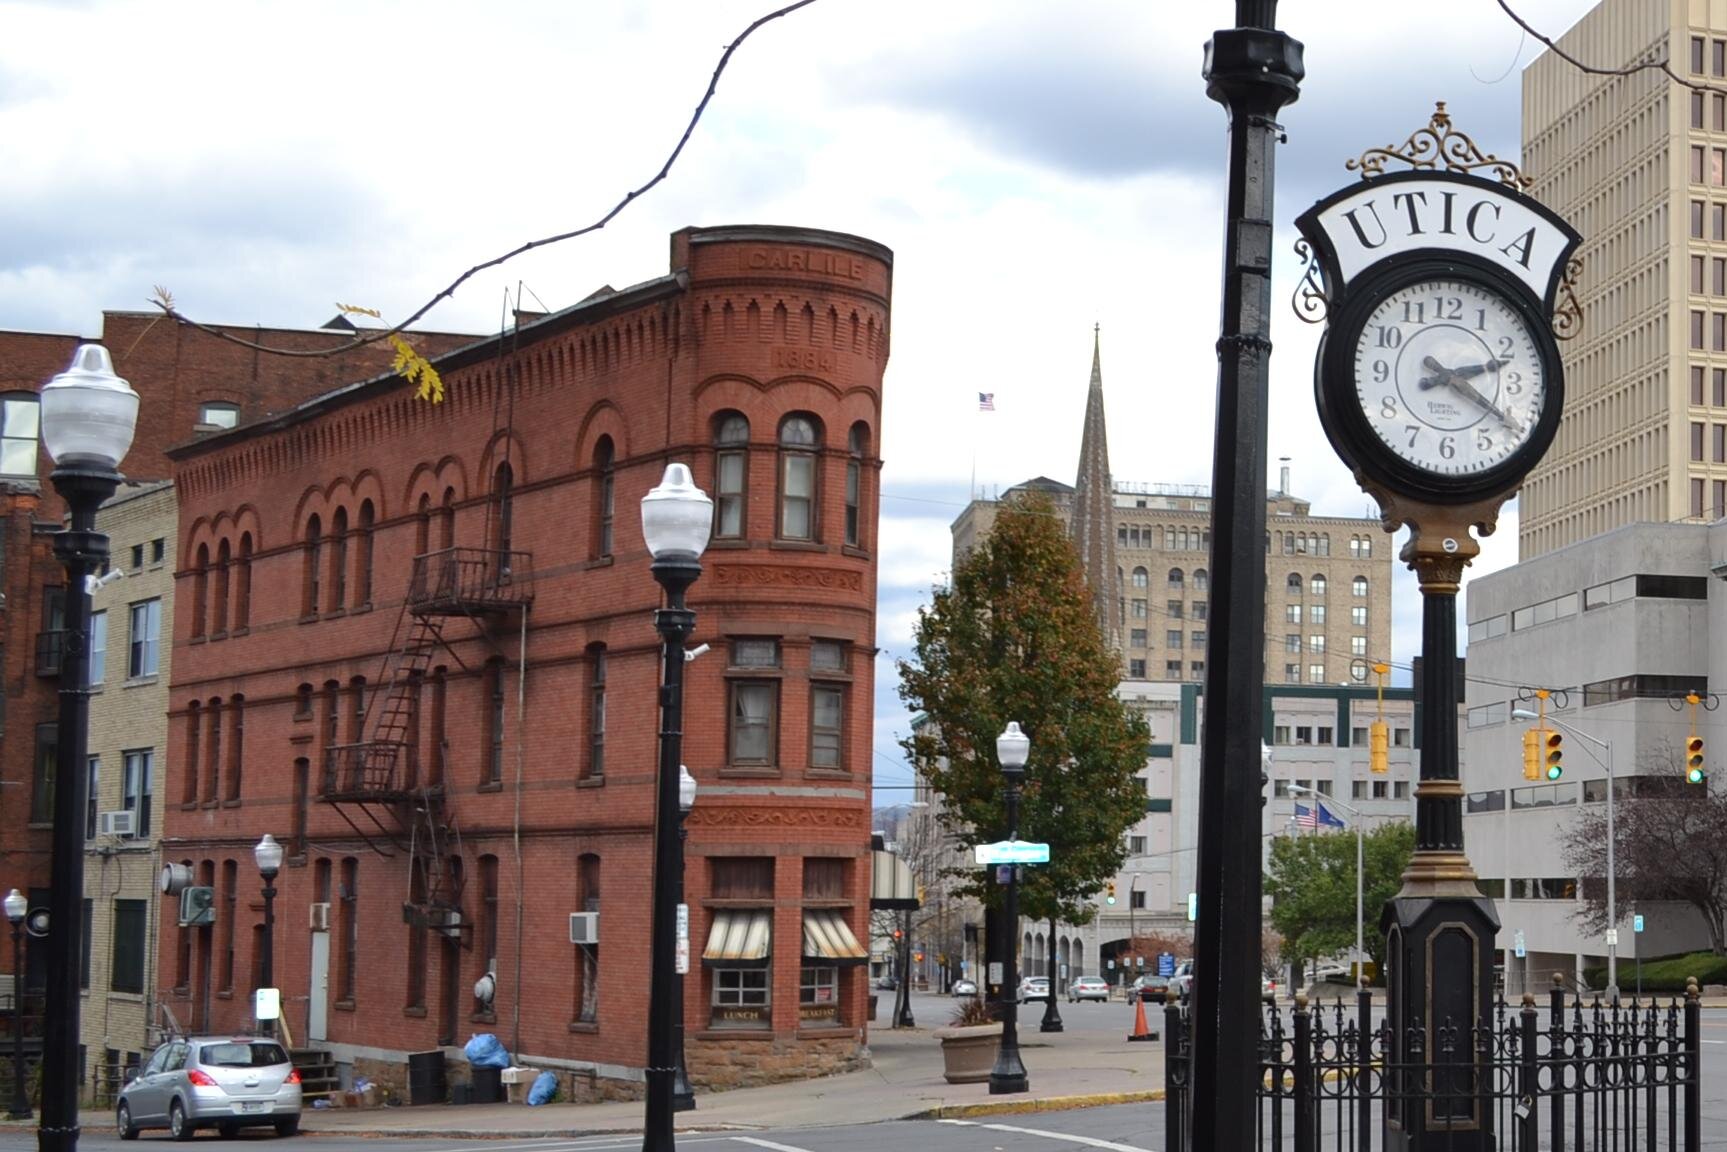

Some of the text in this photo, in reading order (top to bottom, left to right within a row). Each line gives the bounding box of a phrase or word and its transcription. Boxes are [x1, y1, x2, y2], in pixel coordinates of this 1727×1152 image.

[1341, 190, 1540, 271] UTICA
[748, 250, 863, 280] CARLILE
[1401, 300, 1427, 324] 11
[1433, 296, 1463, 320] 12
[1475, 308, 1487, 331] 1
[1374, 325, 1402, 349] 10
[1498, 336, 1515, 359] 2
[775, 350, 833, 372] 1884
[1372, 360, 1389, 383] 9
[1506, 371, 1522, 395] 3
[1380, 395, 1397, 419] 8
[1404, 425, 1421, 448] 7
[1439, 436, 1455, 459] 6
[1477, 428, 1493, 450] 5
[724, 1011, 759, 1020] LUNCH
